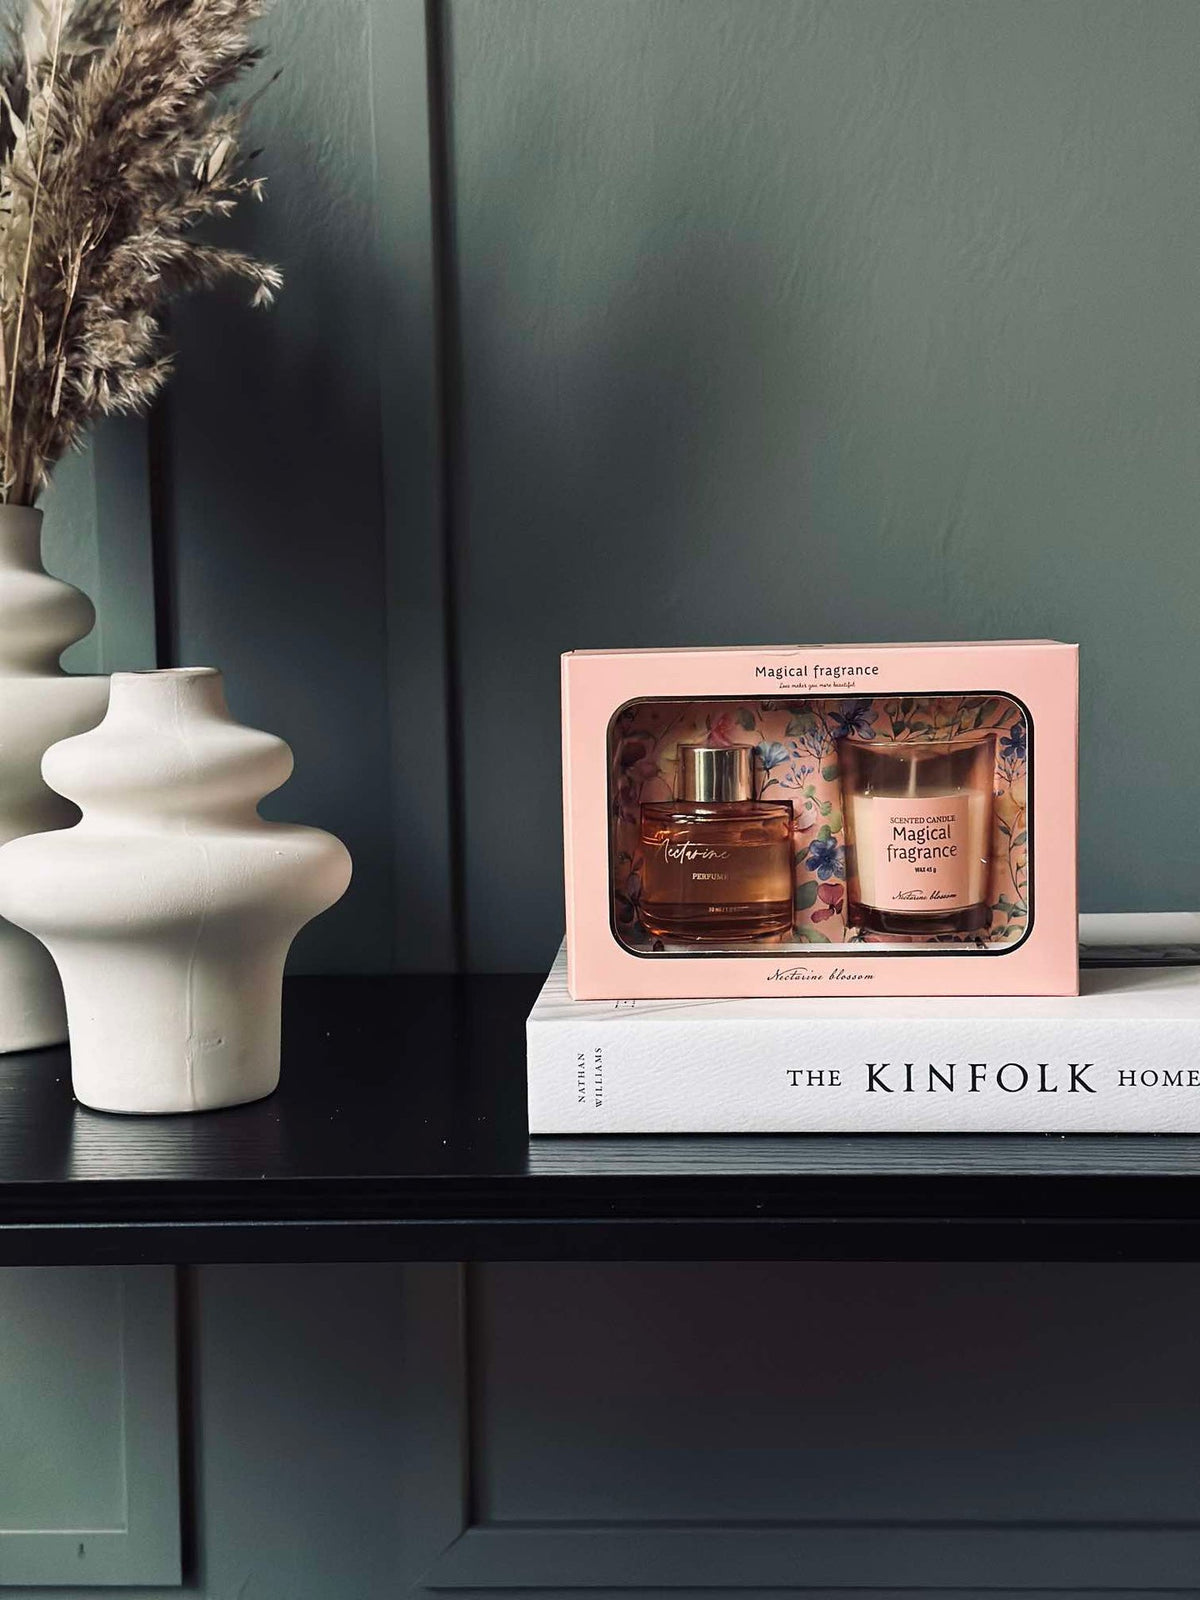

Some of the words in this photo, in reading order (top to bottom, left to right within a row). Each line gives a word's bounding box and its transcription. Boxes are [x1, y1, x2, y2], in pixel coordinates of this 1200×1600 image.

[755, 665, 808, 680] Magical
[813, 664, 879, 679] fragrance
[890, 816, 925, 824] SCENTED
[926, 815, 956, 824] CANDLE
[893, 824, 951, 844] Magical
[887, 844, 957, 863] fragrance
[892, 889, 927, 900] Nectarine
[929, 890, 957, 900] blossom
[767, 966, 823, 981] Nectarine
[828, 968, 874, 981] blossom
[577, 1053, 586, 1103] NATHAN
[595, 1047, 603, 1108] WILLIAMS
[786, 1069, 842, 1087] THE
[865, 1063, 1097, 1093] KINFOLK
[1118, 1069, 1200, 1087] HOME
